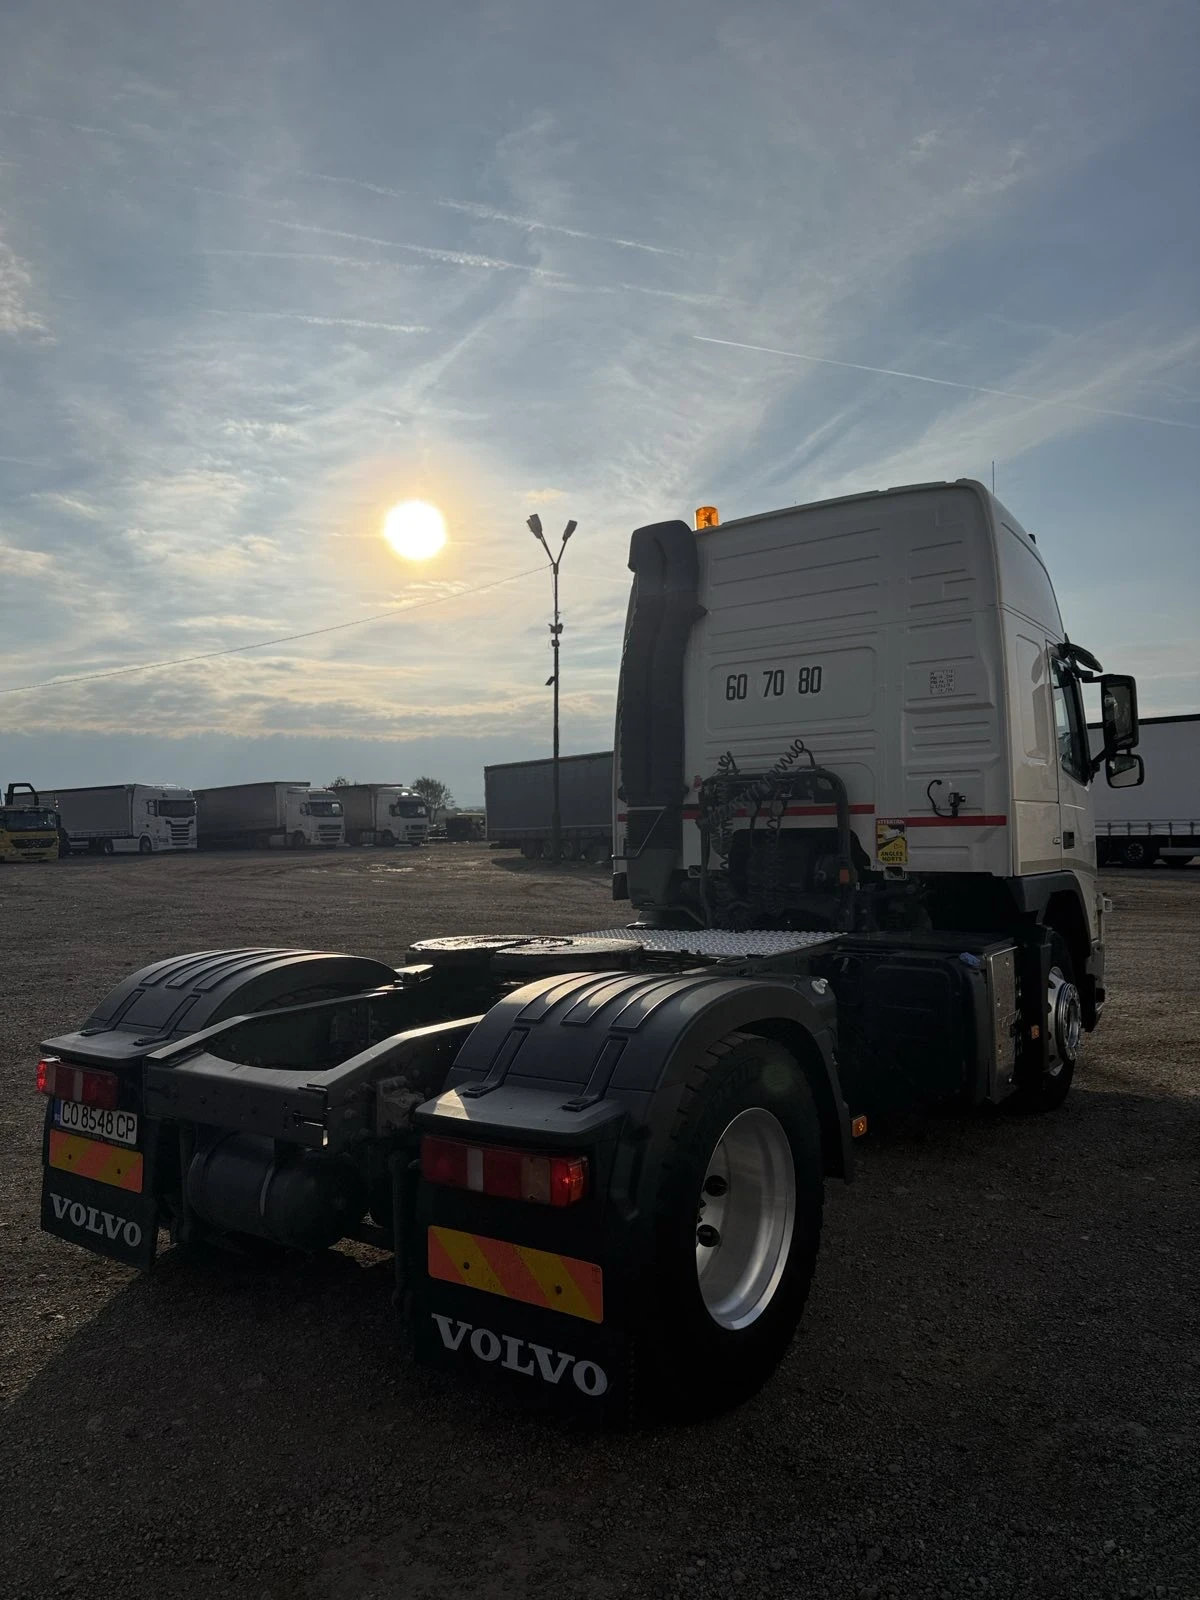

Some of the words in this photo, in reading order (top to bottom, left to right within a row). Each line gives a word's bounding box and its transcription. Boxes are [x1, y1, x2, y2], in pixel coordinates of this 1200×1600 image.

[726, 674, 748, 701] 60
[763, 669, 785, 698] 70
[798, 666, 822, 694] 80
[81, 1106, 114, 1135] 8548
[116, 1114, 136, 1140] CP
[49, 1193, 142, 1247] VOLVO
[431, 1312, 608, 1396] VOLVO
